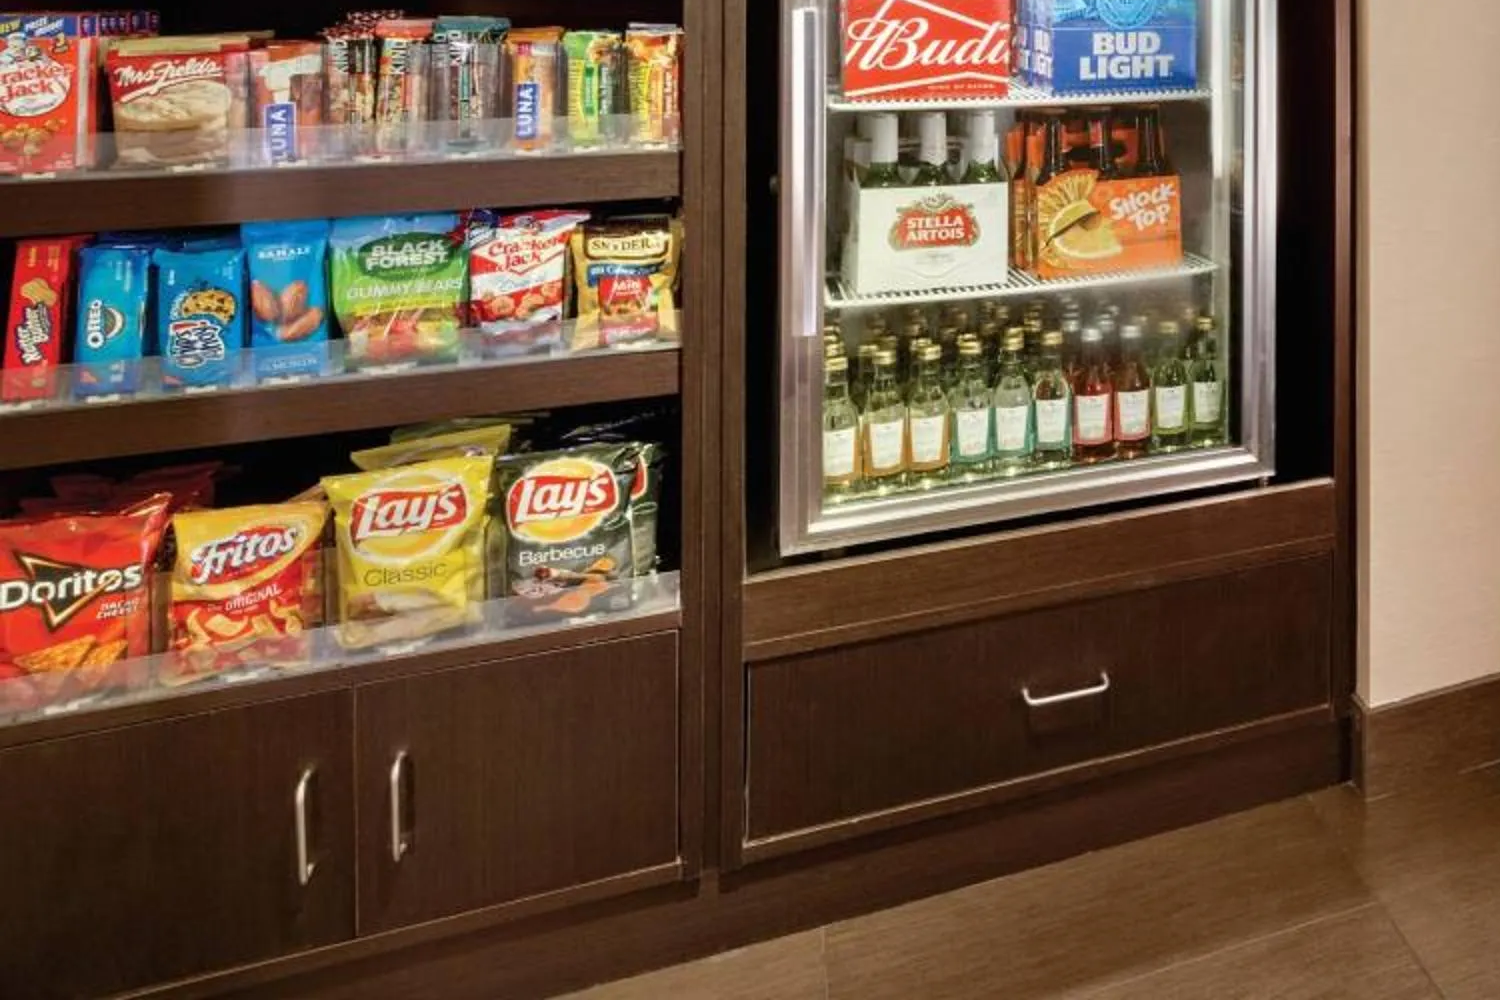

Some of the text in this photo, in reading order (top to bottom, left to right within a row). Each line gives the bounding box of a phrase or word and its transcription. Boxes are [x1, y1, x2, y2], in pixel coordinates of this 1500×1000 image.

[1092, 31, 1161, 56] BUD
[1079, 55, 1175, 81] LIGHT
[518, 86, 534, 137] LUNA
[270, 108, 289, 160] LUNA
[906, 215, 965, 230] STELLA
[906, 227, 967, 242] ARTOIS
[364, 250, 449, 272] FOREST
[371, 239, 445, 259] BLACK
[502, 249, 542, 272] Jack
[87, 299, 105, 349] OREO
[515, 471, 612, 525] Lay's
[355, 486, 465, 541] Lay's
[191, 526, 299, 586] Fritos
[519, 542, 607, 567] Barbecue
[0, 563, 145, 612] Doritos
[363, 561, 449, 588] Classic
